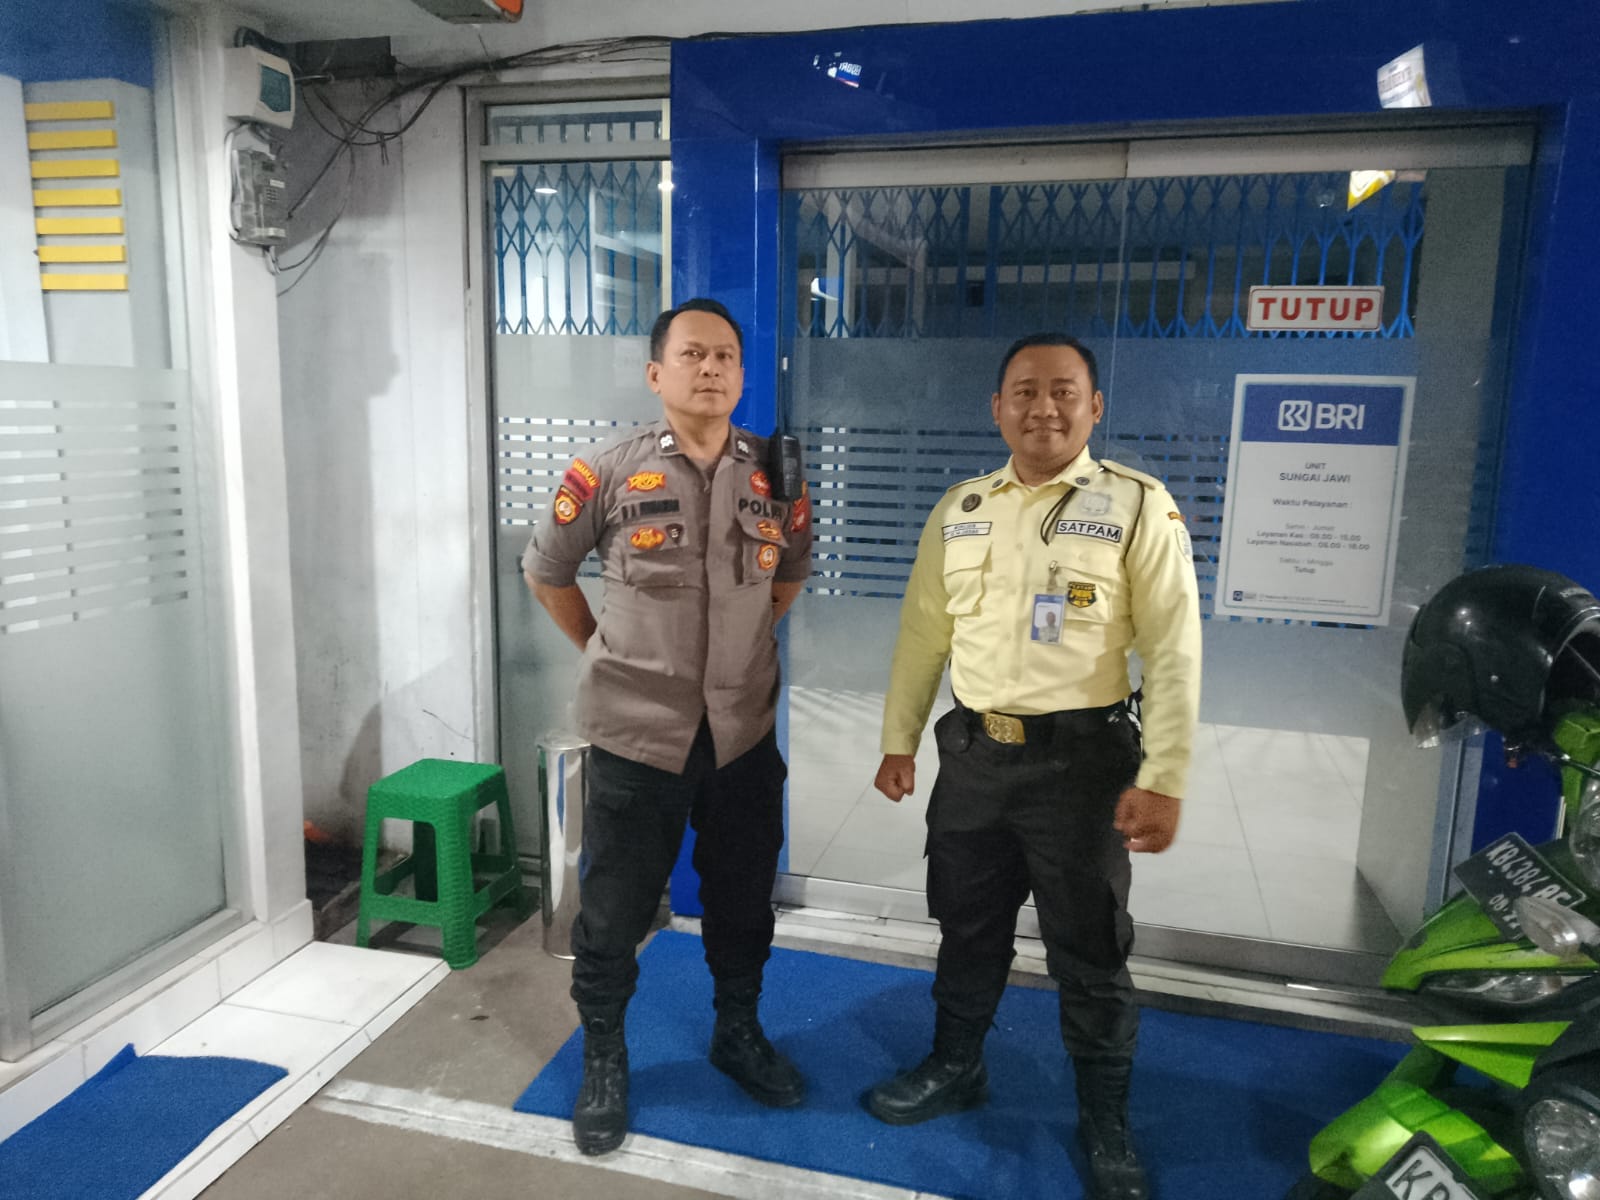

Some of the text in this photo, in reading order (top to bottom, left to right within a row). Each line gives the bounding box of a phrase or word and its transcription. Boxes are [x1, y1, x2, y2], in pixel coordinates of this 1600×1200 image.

[1257, 297, 1374, 321] TUTUP
[1315, 403, 1366, 430] BRI
[1304, 462, 1327, 470] UNIT
[1279, 472, 1351, 483] SUNGAI JAWI
[1273, 498, 1348, 509] Waktu Pelayanan
[1059, 522, 1121, 540] SATPAM
